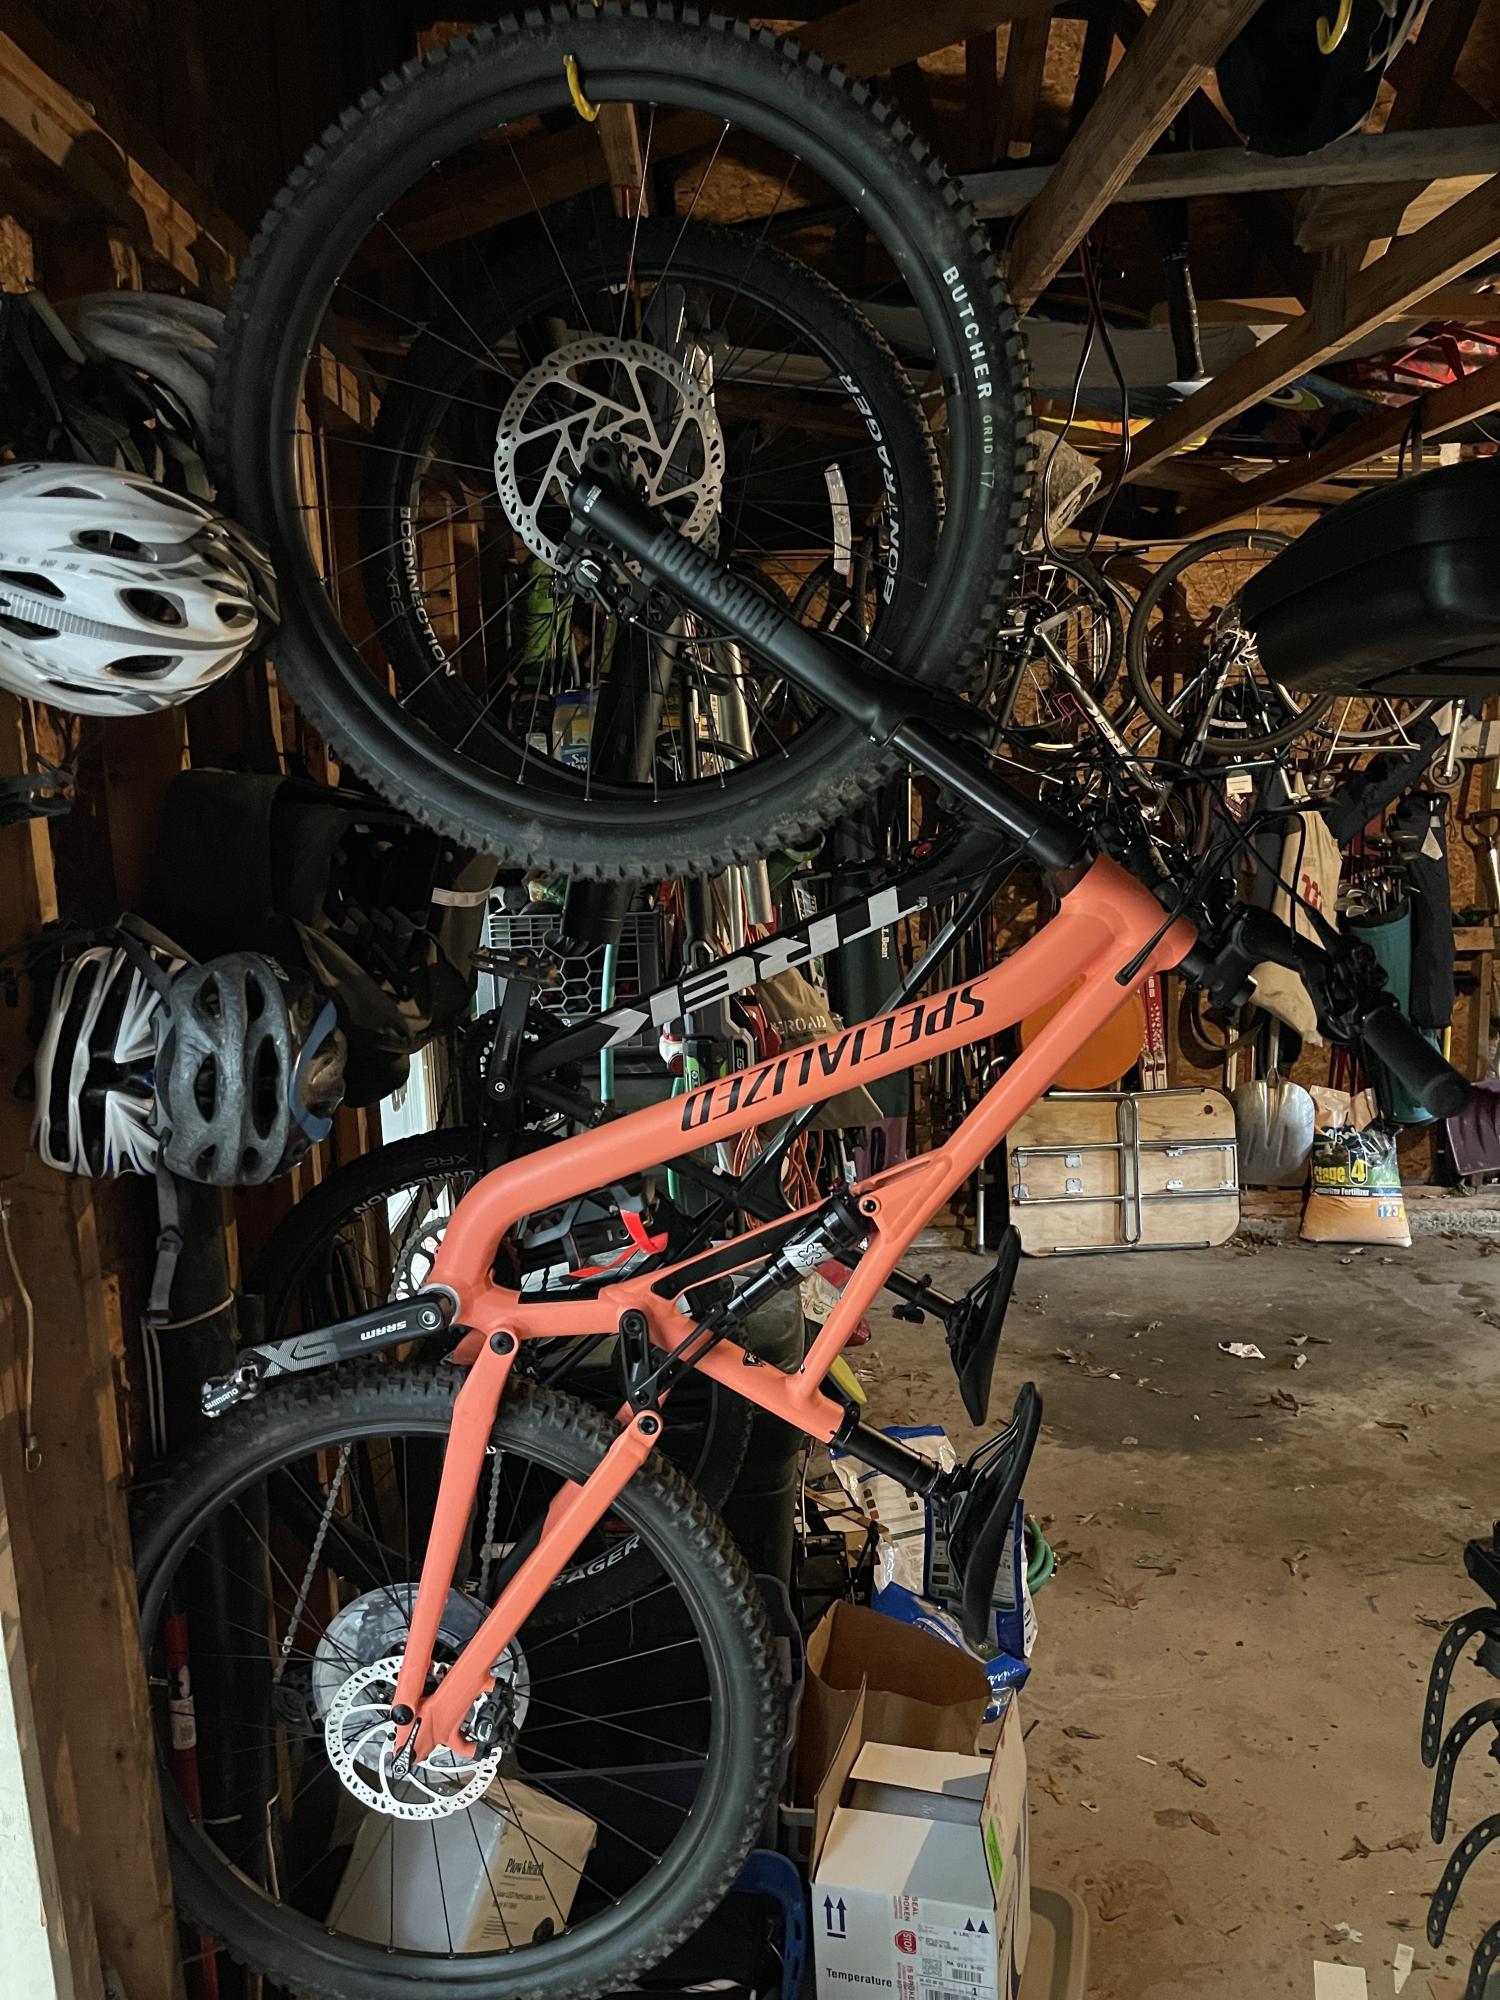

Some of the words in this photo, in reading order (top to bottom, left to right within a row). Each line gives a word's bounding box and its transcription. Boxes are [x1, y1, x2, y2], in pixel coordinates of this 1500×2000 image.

[943, 266, 993, 400] BUTCHER
[982, 414, 994, 454] GRID
[839, 374, 900, 605] BONTRAGER
[980, 470, 996, 489] T7
[400, 520, 457, 678] CONNECTION
[650, 528, 786, 644] ROCKSHOX
[595, 886, 928, 1049] TREK
[681, 977, 990, 1131] SPECIALIZED
[736, 1047, 745, 1070] EG
[424, 1154, 470, 1169] XR2
[1313, 1165, 1346, 1184] Stage
[1350, 1158, 1366, 1182] 4
[353, 1169, 484, 1214] ONNECTION
[360, 1320, 407, 1341] SRAM
[204, 1387, 239, 1411] SHIMANO
[505, 1858, 521, 1874] Plow
[902, 1933, 914, 1952] STOP
[826, 1967, 893, 1988] Temperature
